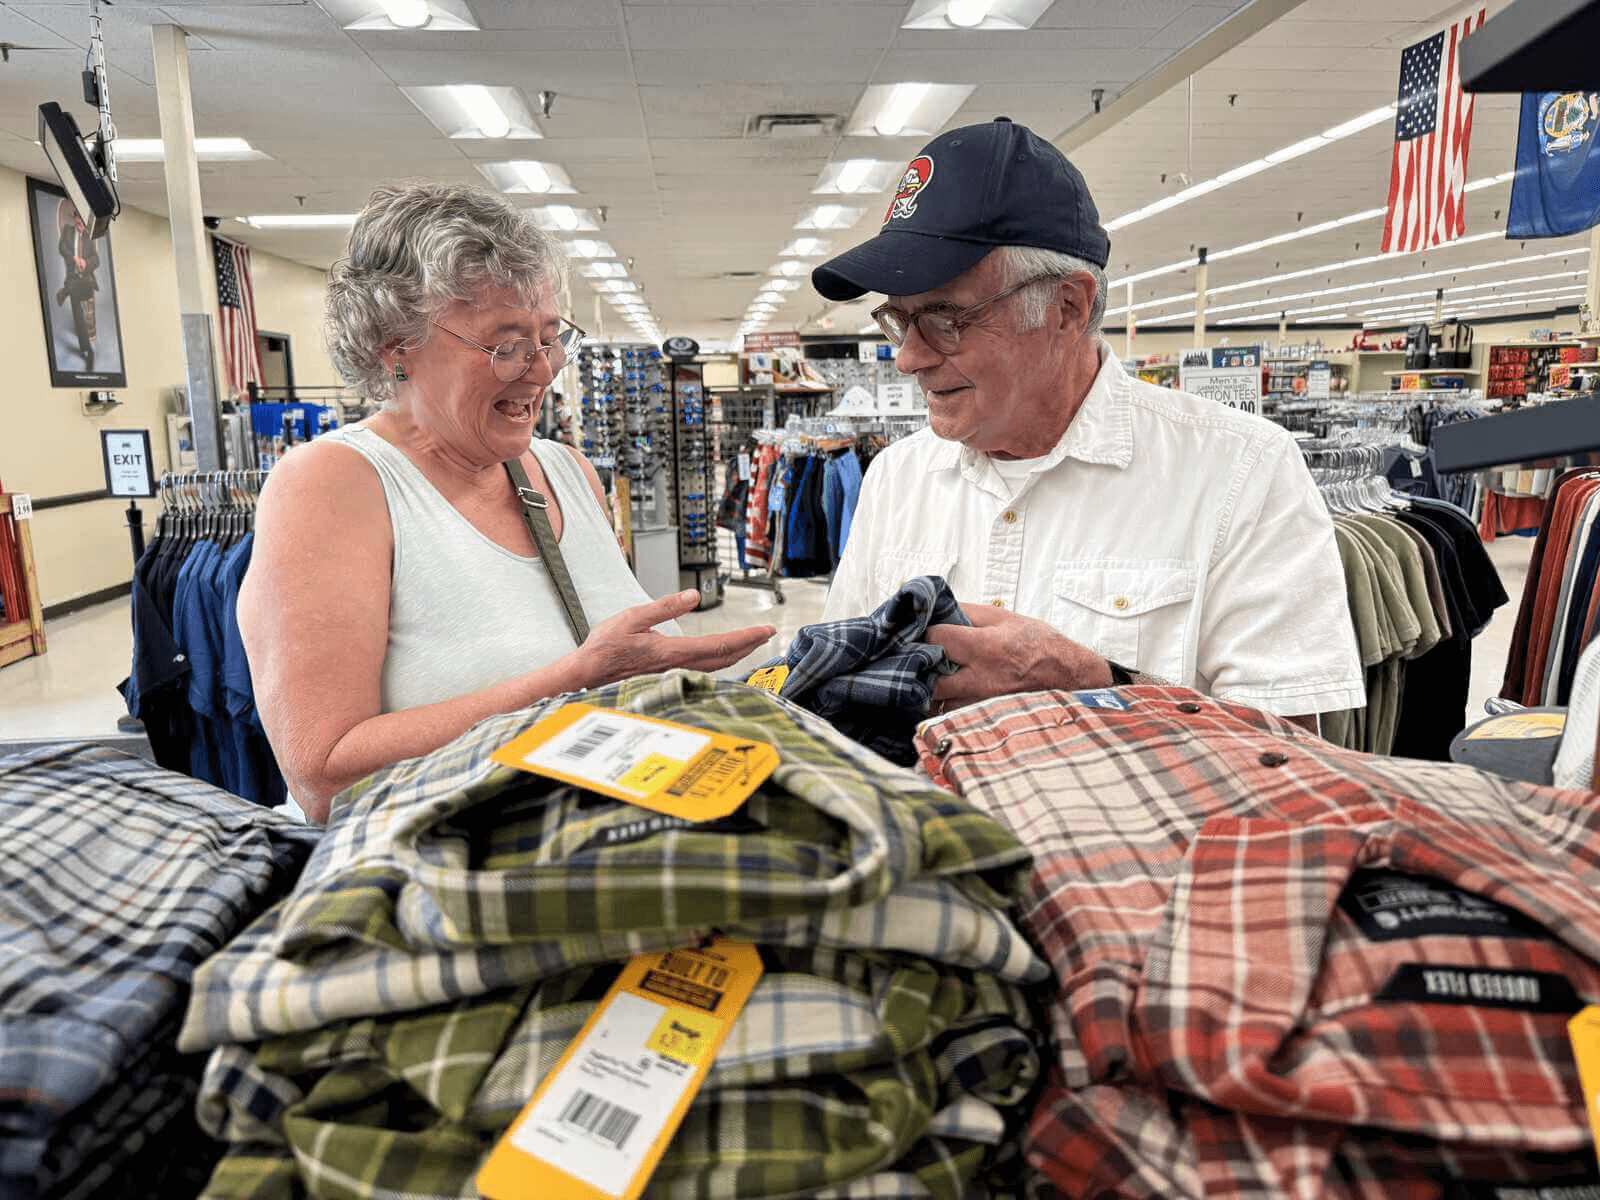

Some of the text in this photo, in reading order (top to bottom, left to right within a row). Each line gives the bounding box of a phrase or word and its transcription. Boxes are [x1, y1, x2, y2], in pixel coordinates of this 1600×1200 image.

[1209, 376, 1238, 385] Men's
[1190, 388, 1257, 402] OTTON TEES
[113, 454, 142, 465] EXIT
[1422, 969, 1541, 1004] RUGGED FLEX
